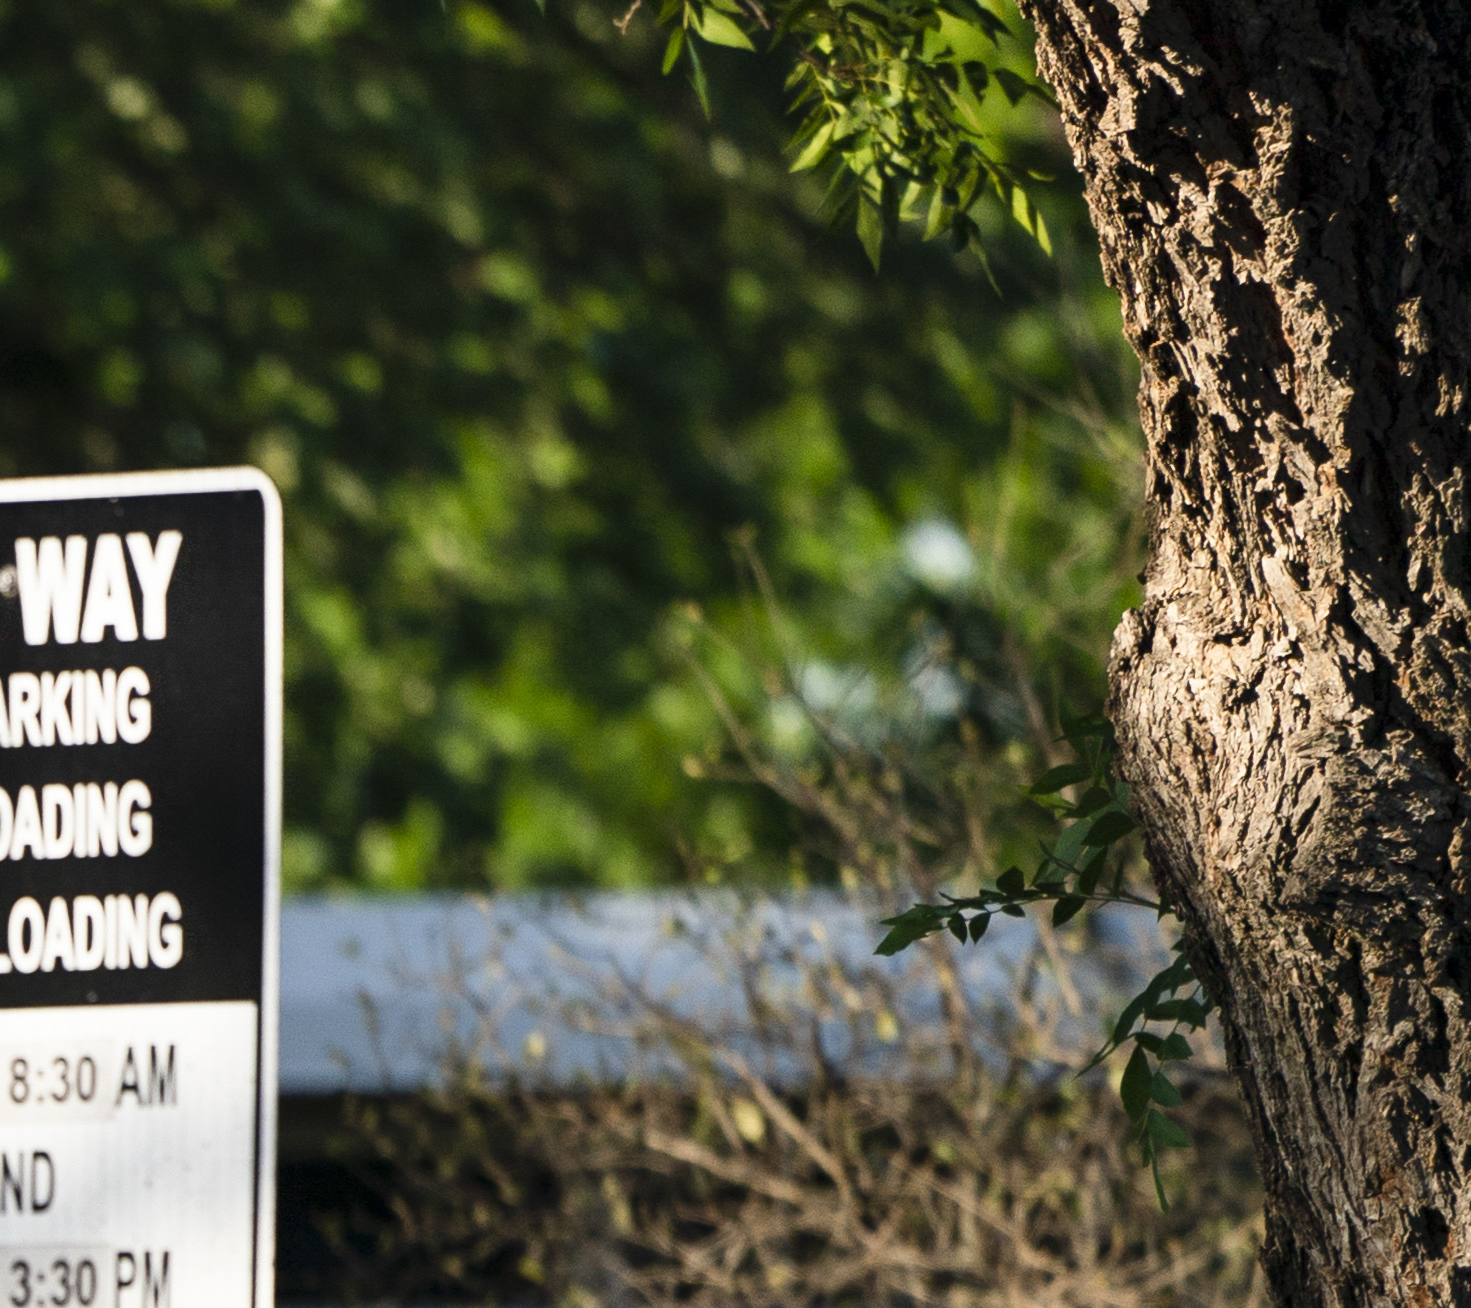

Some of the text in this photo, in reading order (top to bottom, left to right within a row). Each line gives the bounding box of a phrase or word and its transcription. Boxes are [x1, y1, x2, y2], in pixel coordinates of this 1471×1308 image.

[15, 530, 183, 645] WAY
[9, 1054, 99, 1105] 8:30
[115, 1045, 179, 1108] AM
[11, 1257, 98, 1308] 3:30
